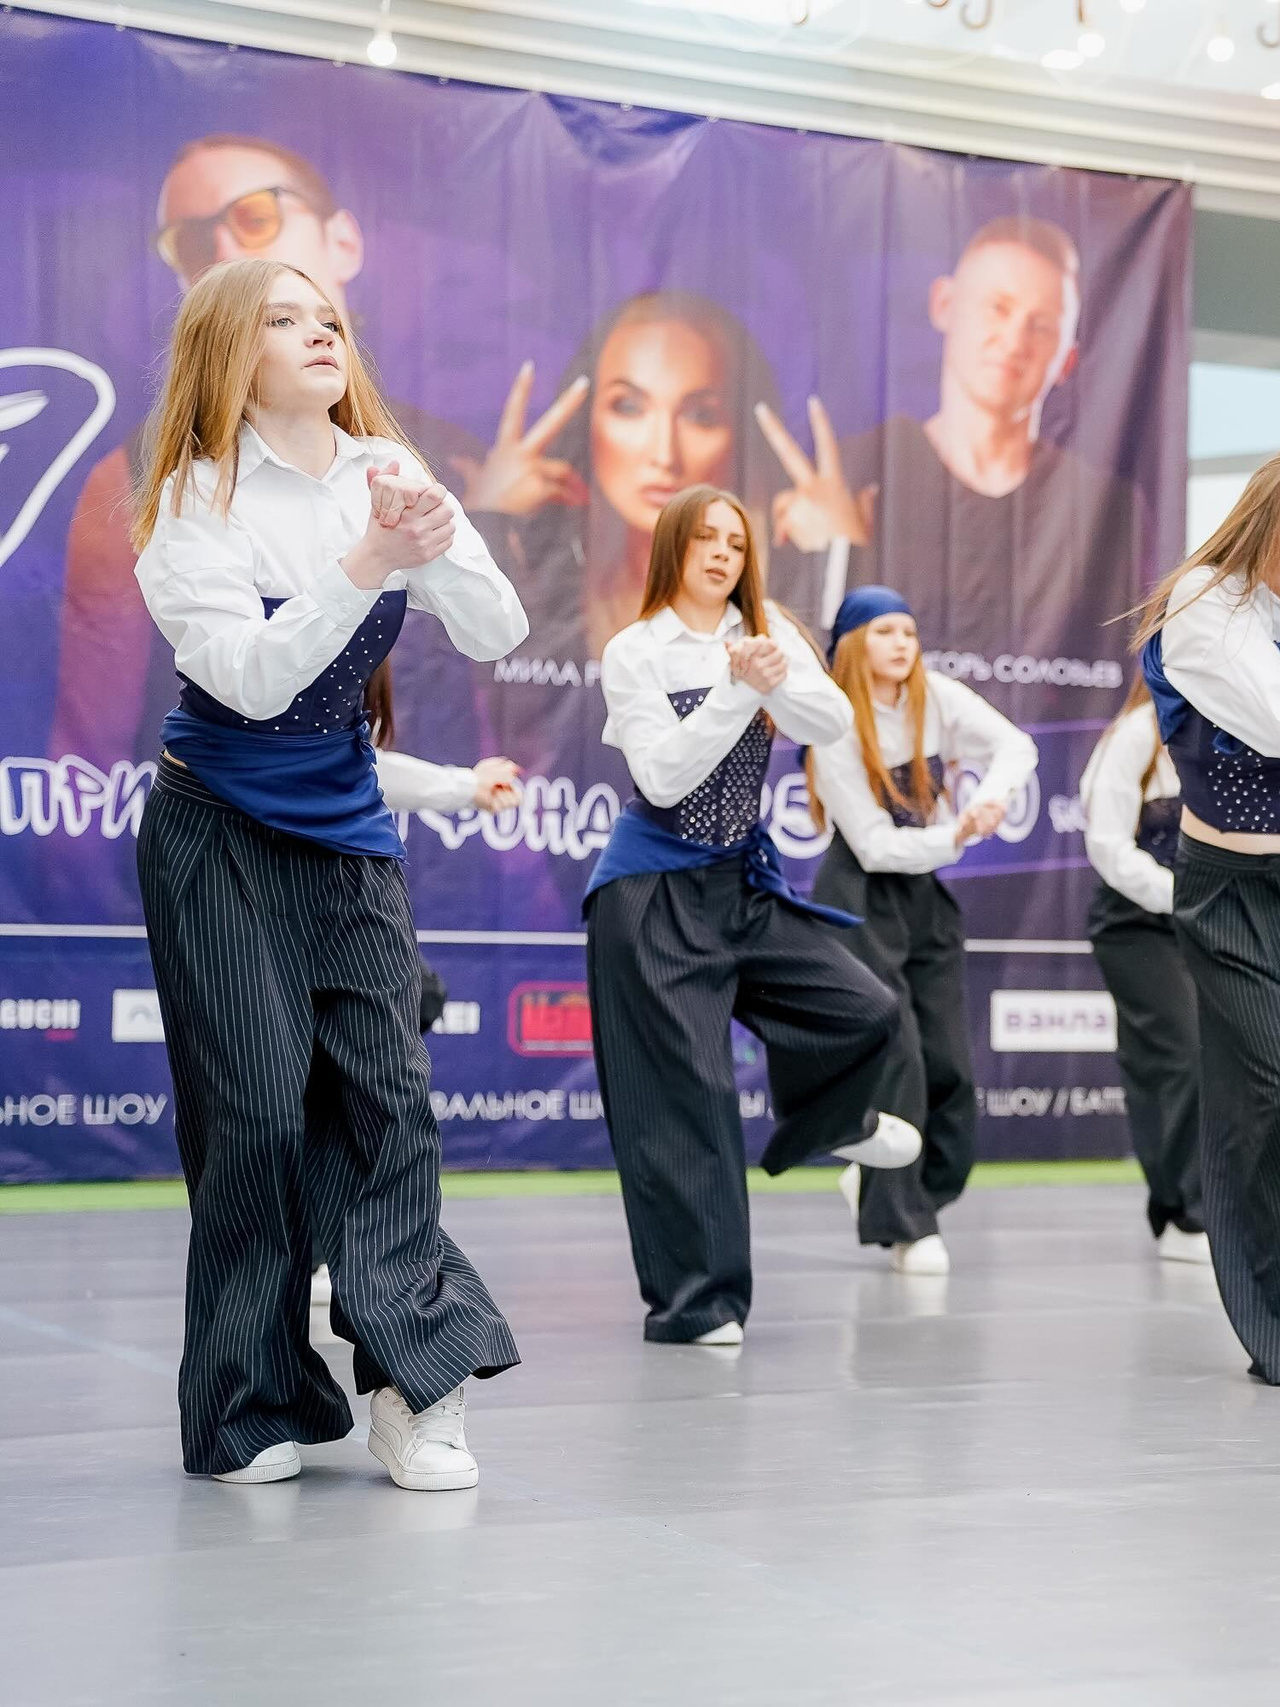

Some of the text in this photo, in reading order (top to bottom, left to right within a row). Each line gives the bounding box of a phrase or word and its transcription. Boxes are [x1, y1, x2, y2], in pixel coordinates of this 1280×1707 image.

[494, 657, 582, 687] МИЛА
[921, 650, 993, 682] ГОРЬ
[0, 753, 158, 839] ПРИ
[83, 1092, 168, 1125] ШОУ
